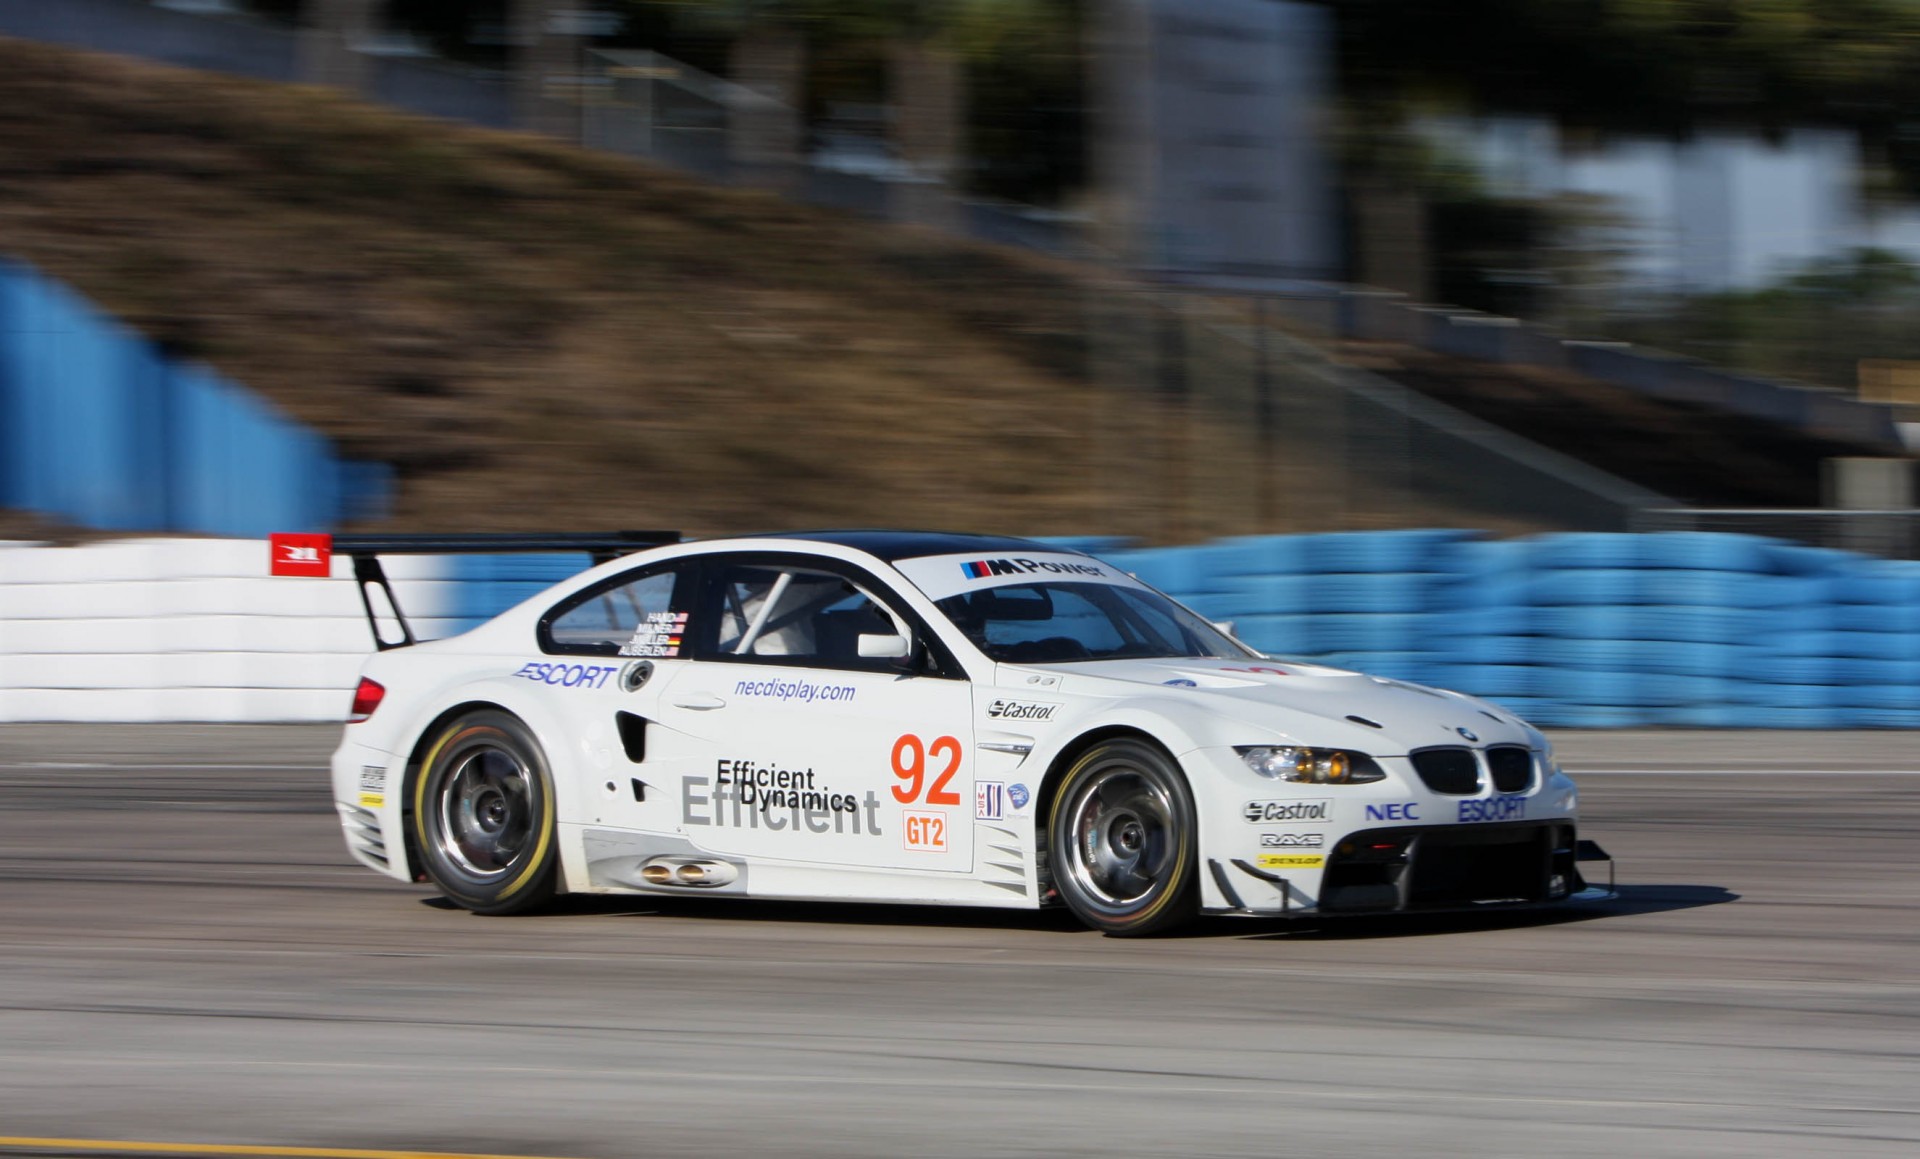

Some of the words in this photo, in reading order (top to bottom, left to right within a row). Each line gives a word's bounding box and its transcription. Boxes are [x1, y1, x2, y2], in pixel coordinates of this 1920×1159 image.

[511, 662, 619, 689] ESCORT
[734, 678, 856, 703] necdisplay.com
[1002, 701, 1057, 720] Castrol
[717, 759, 815, 790] Efficient
[890, 733, 963, 806] 92
[682, 775, 883, 836] Efficient
[740, 780, 858, 813] Dynamics
[1264, 802, 1327, 821] Castrol
[1365, 802, 1420, 821] NEC
[1457, 797, 1528, 822] ESCORT
[906, 816, 945, 846] GT2
[1260, 833, 1323, 848] RAYS
[1267, 857, 1323, 865] DUNLOP
